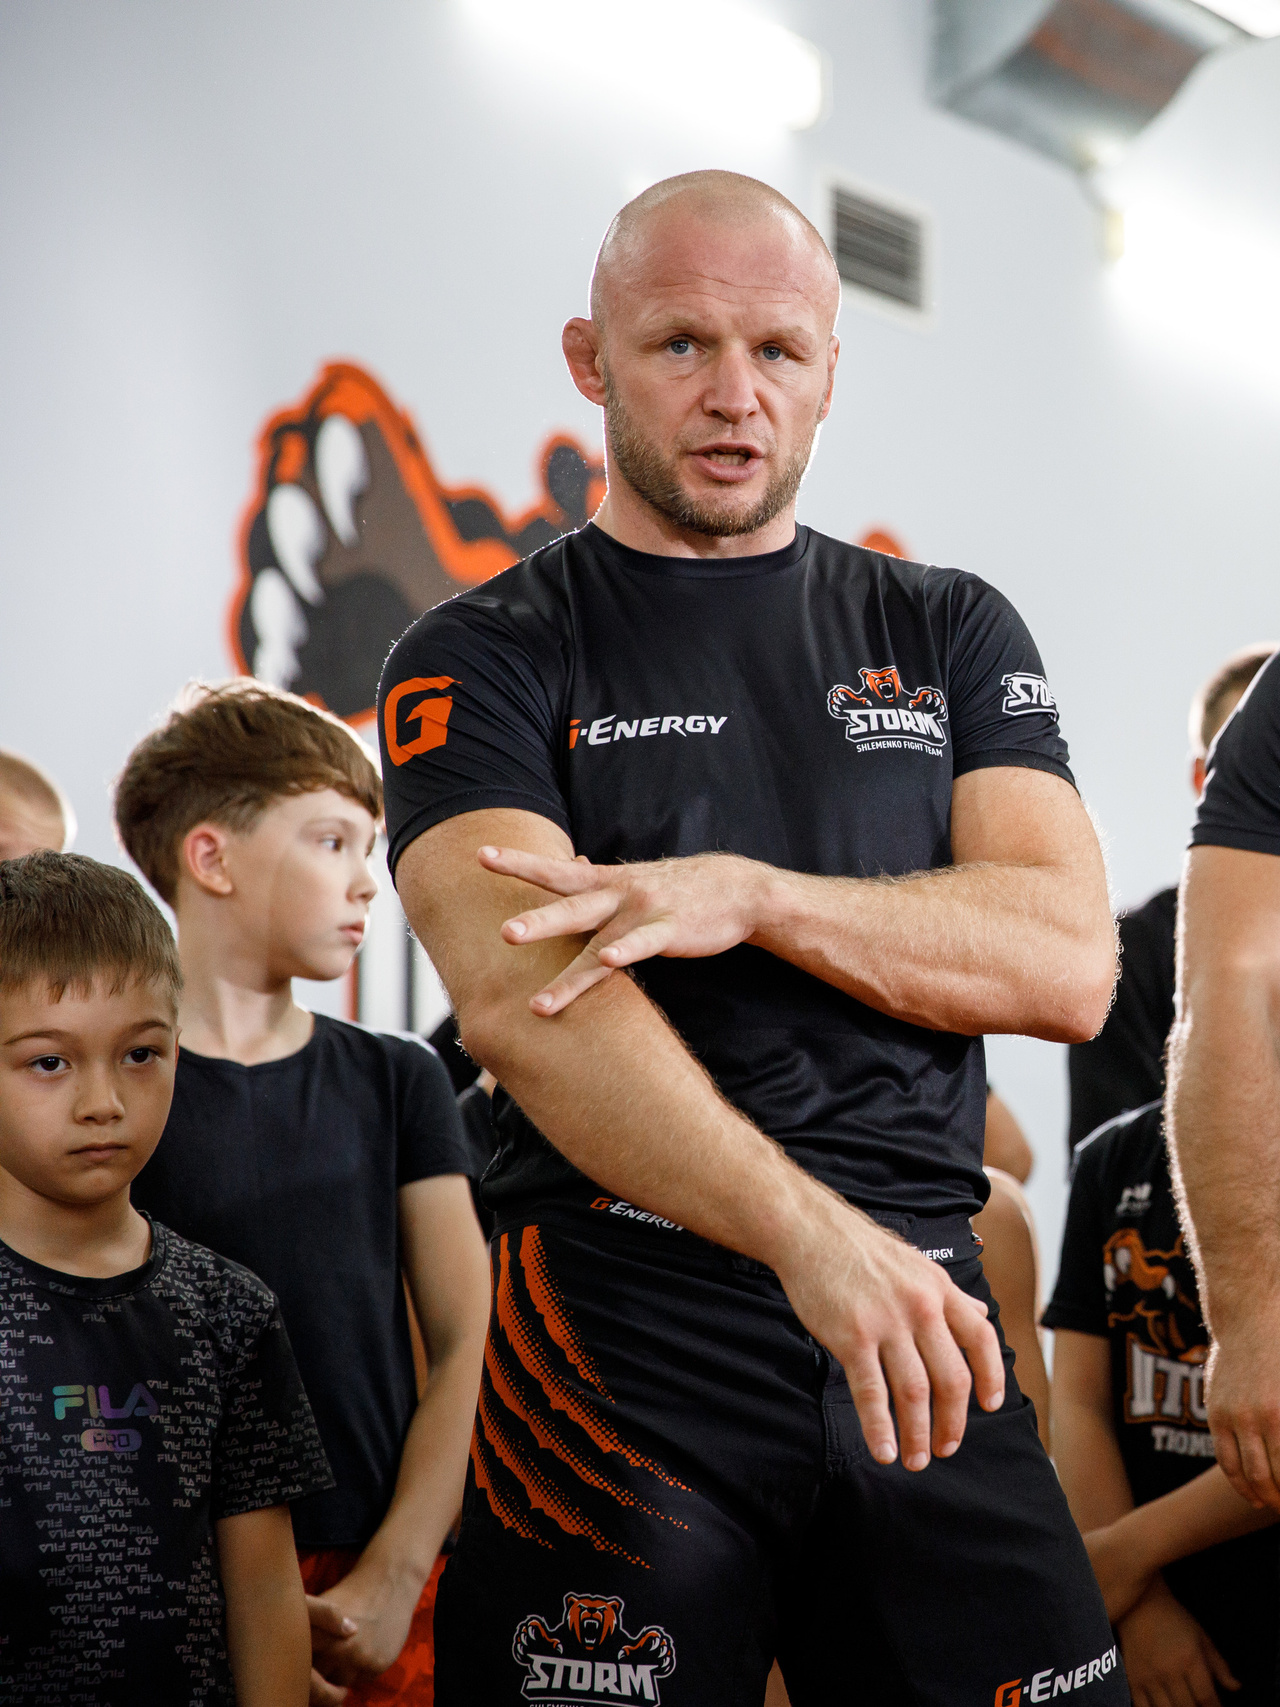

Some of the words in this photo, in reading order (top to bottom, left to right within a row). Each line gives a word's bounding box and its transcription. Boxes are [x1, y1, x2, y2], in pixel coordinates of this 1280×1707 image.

[843, 709, 944, 739] STORM
[856, 740, 903, 753] SHLEMENKO
[903, 741, 924, 752] FIGHT
[924, 744, 943, 758] TEAM
[29, 1335, 54, 1344] FILA
[52, 1382, 159, 1420] FILA
[93, 1433, 130, 1447] PRO
[526, 1653, 660, 1701] STORM
